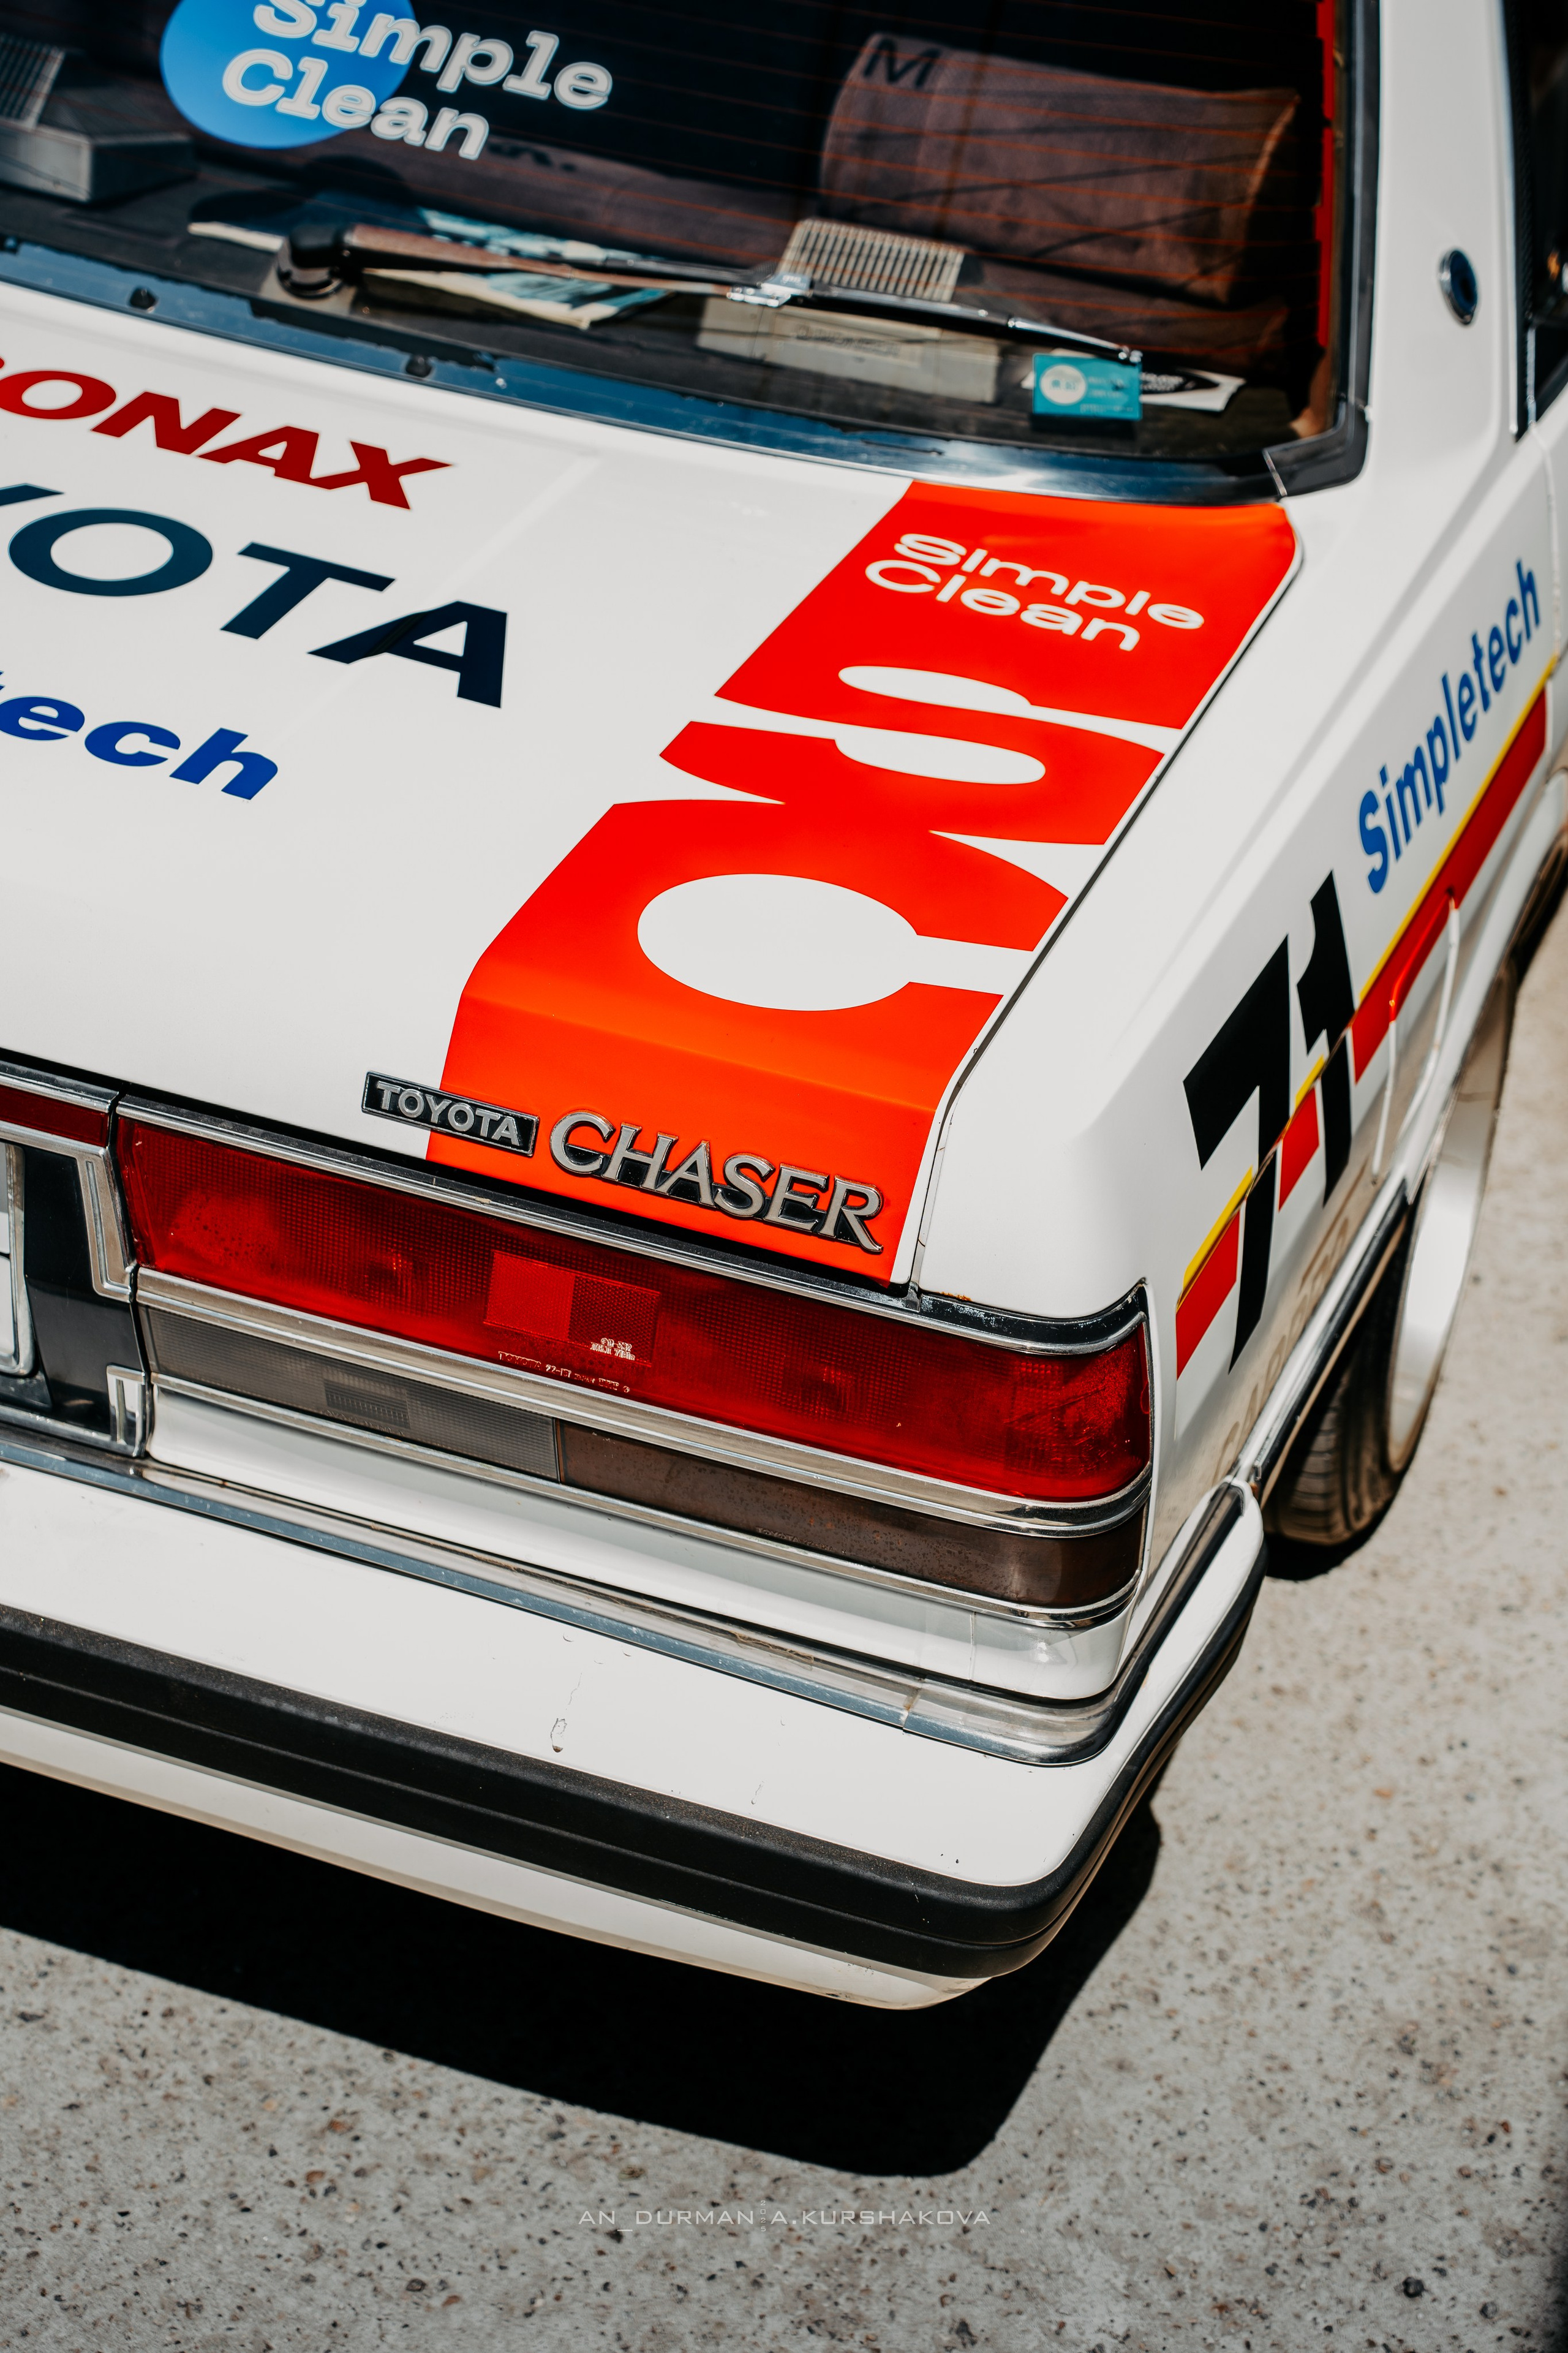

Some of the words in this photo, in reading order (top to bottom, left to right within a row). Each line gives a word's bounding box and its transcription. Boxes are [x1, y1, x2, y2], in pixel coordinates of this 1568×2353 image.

[222, 49, 489, 161] Clean
[252, 0, 613, 110] Simple
[0, 355, 453, 510] ONAX
[865, 559, 1141, 652] Clean
[894, 533, 1205, 630] Simple
[0, 671, 279, 801] ech
[1358, 560, 1541, 895] Simpletech
[375, 1080, 520, 1147] TOYOTA
[1182, 869, 1357, 1375] 71
[549, 1109, 884, 1254] CHASER
[498, 1351, 541, 1370] TOYOTA
